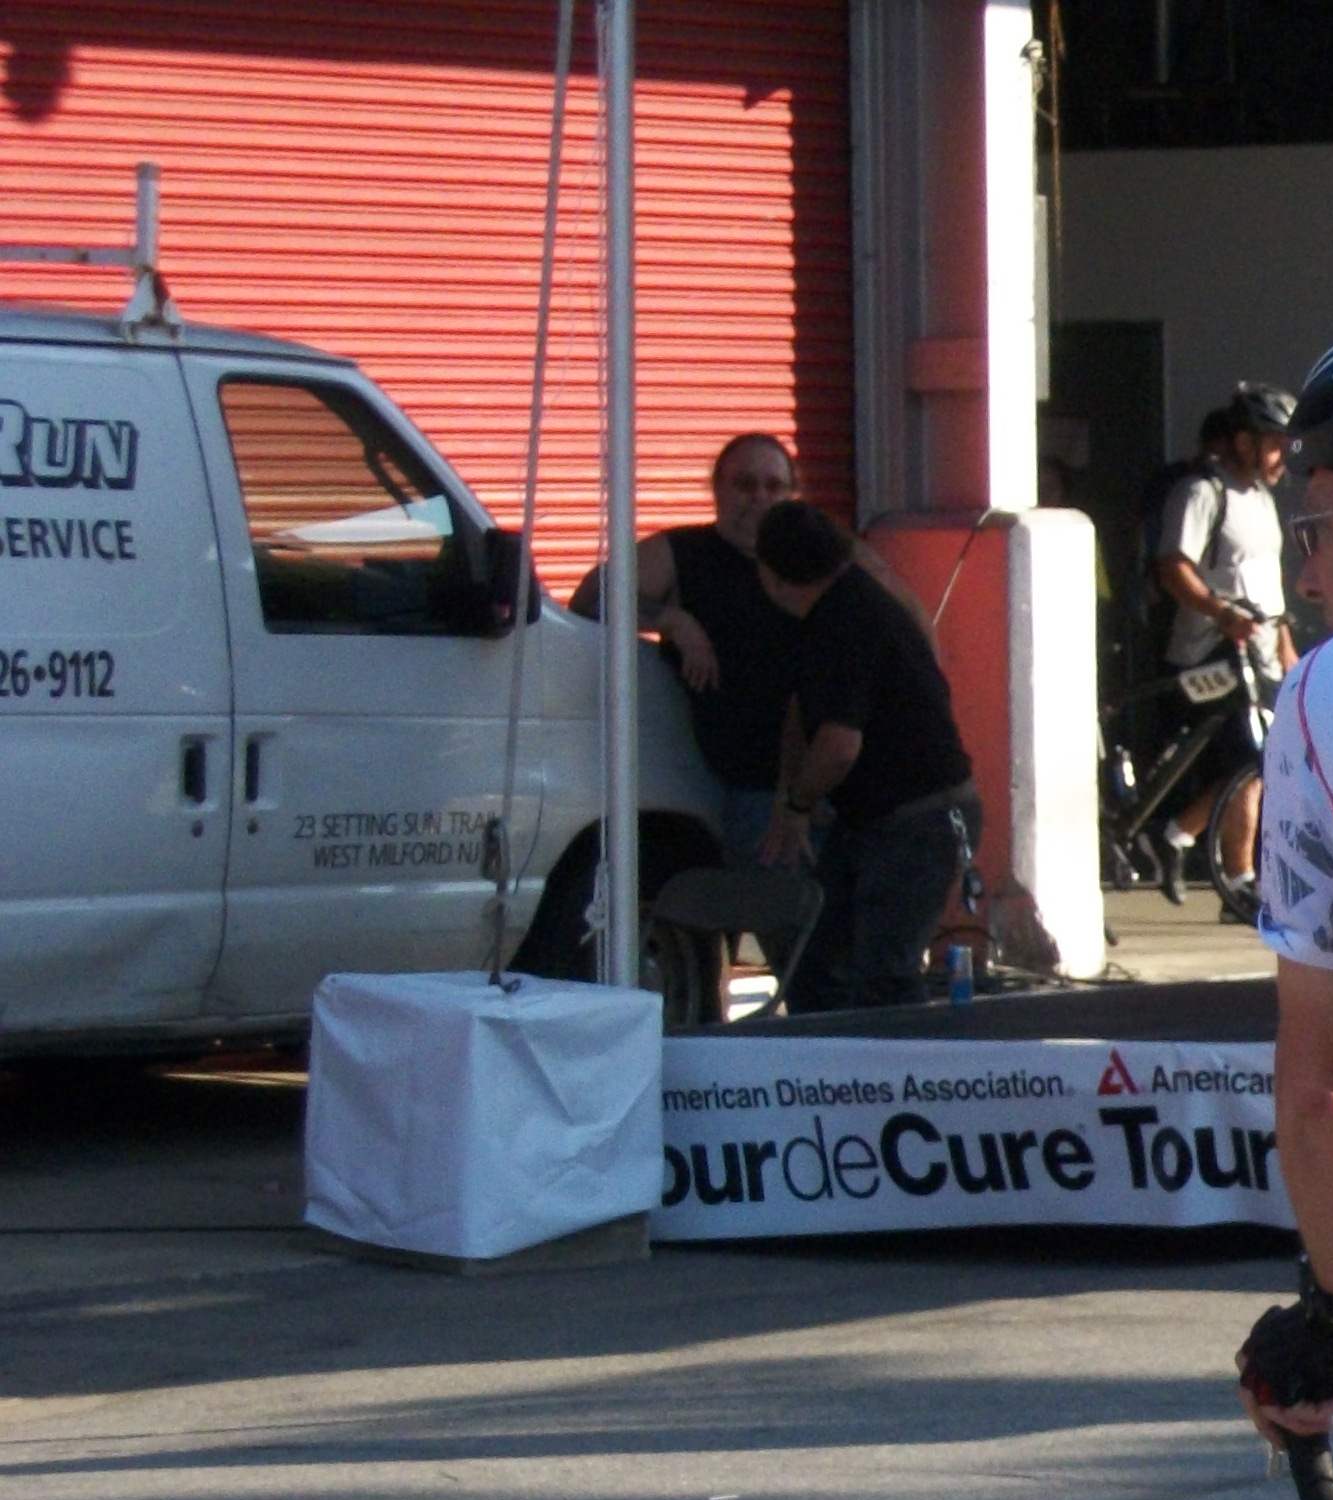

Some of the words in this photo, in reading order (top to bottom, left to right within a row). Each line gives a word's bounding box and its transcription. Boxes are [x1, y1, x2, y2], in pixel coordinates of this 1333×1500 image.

[0, 517, 136, 561] ERVICE
[322, 812, 397, 837] SETTING
[403, 811, 441, 836] SUN
[313, 845, 364, 869] WEST
[368, 843, 451, 867] MILFORD
[662, 1082, 770, 1111] merican
[775, 1076, 894, 1108] Diabetes
[902, 1070, 1065, 1101] Association
